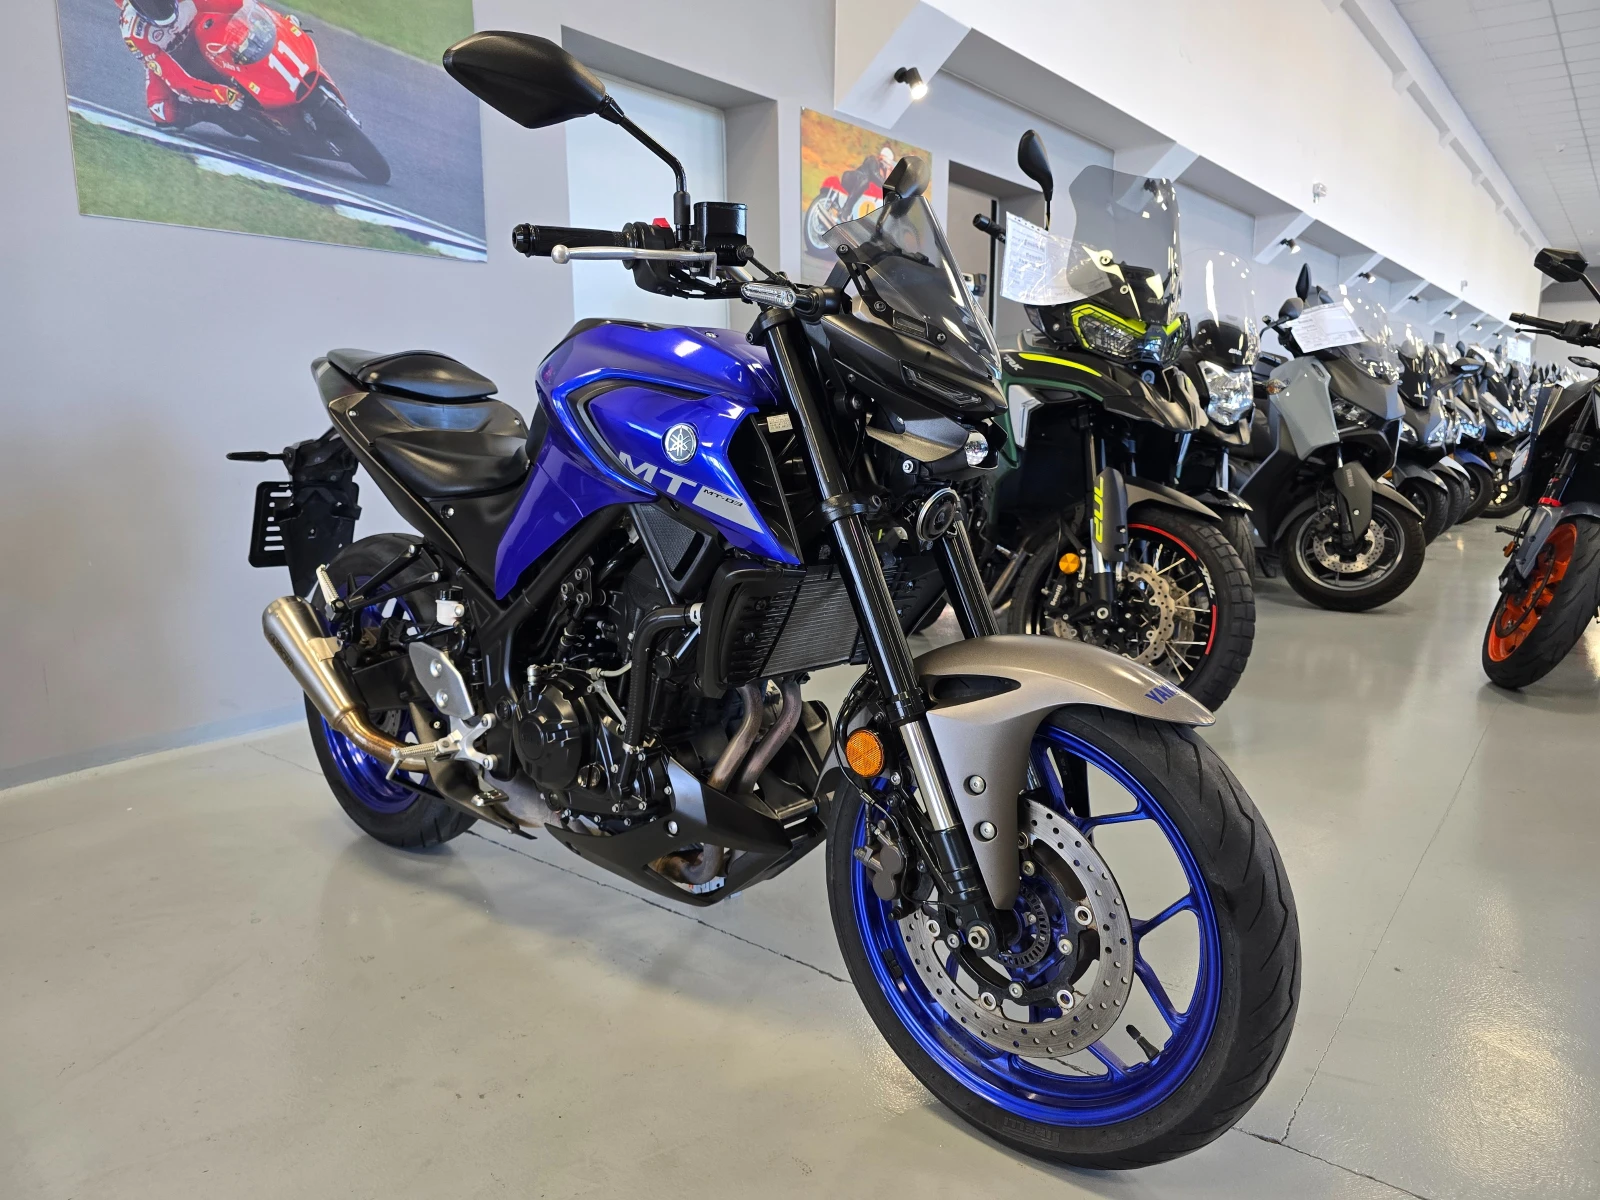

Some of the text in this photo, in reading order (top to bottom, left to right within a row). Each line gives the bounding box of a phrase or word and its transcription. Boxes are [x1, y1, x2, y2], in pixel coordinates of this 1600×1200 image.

[269, 40, 309, 93] 11
[1003, 353, 1024, 371] TRK
[618, 451, 698, 496] MT
[703, 488, 743, 507] MT-03
